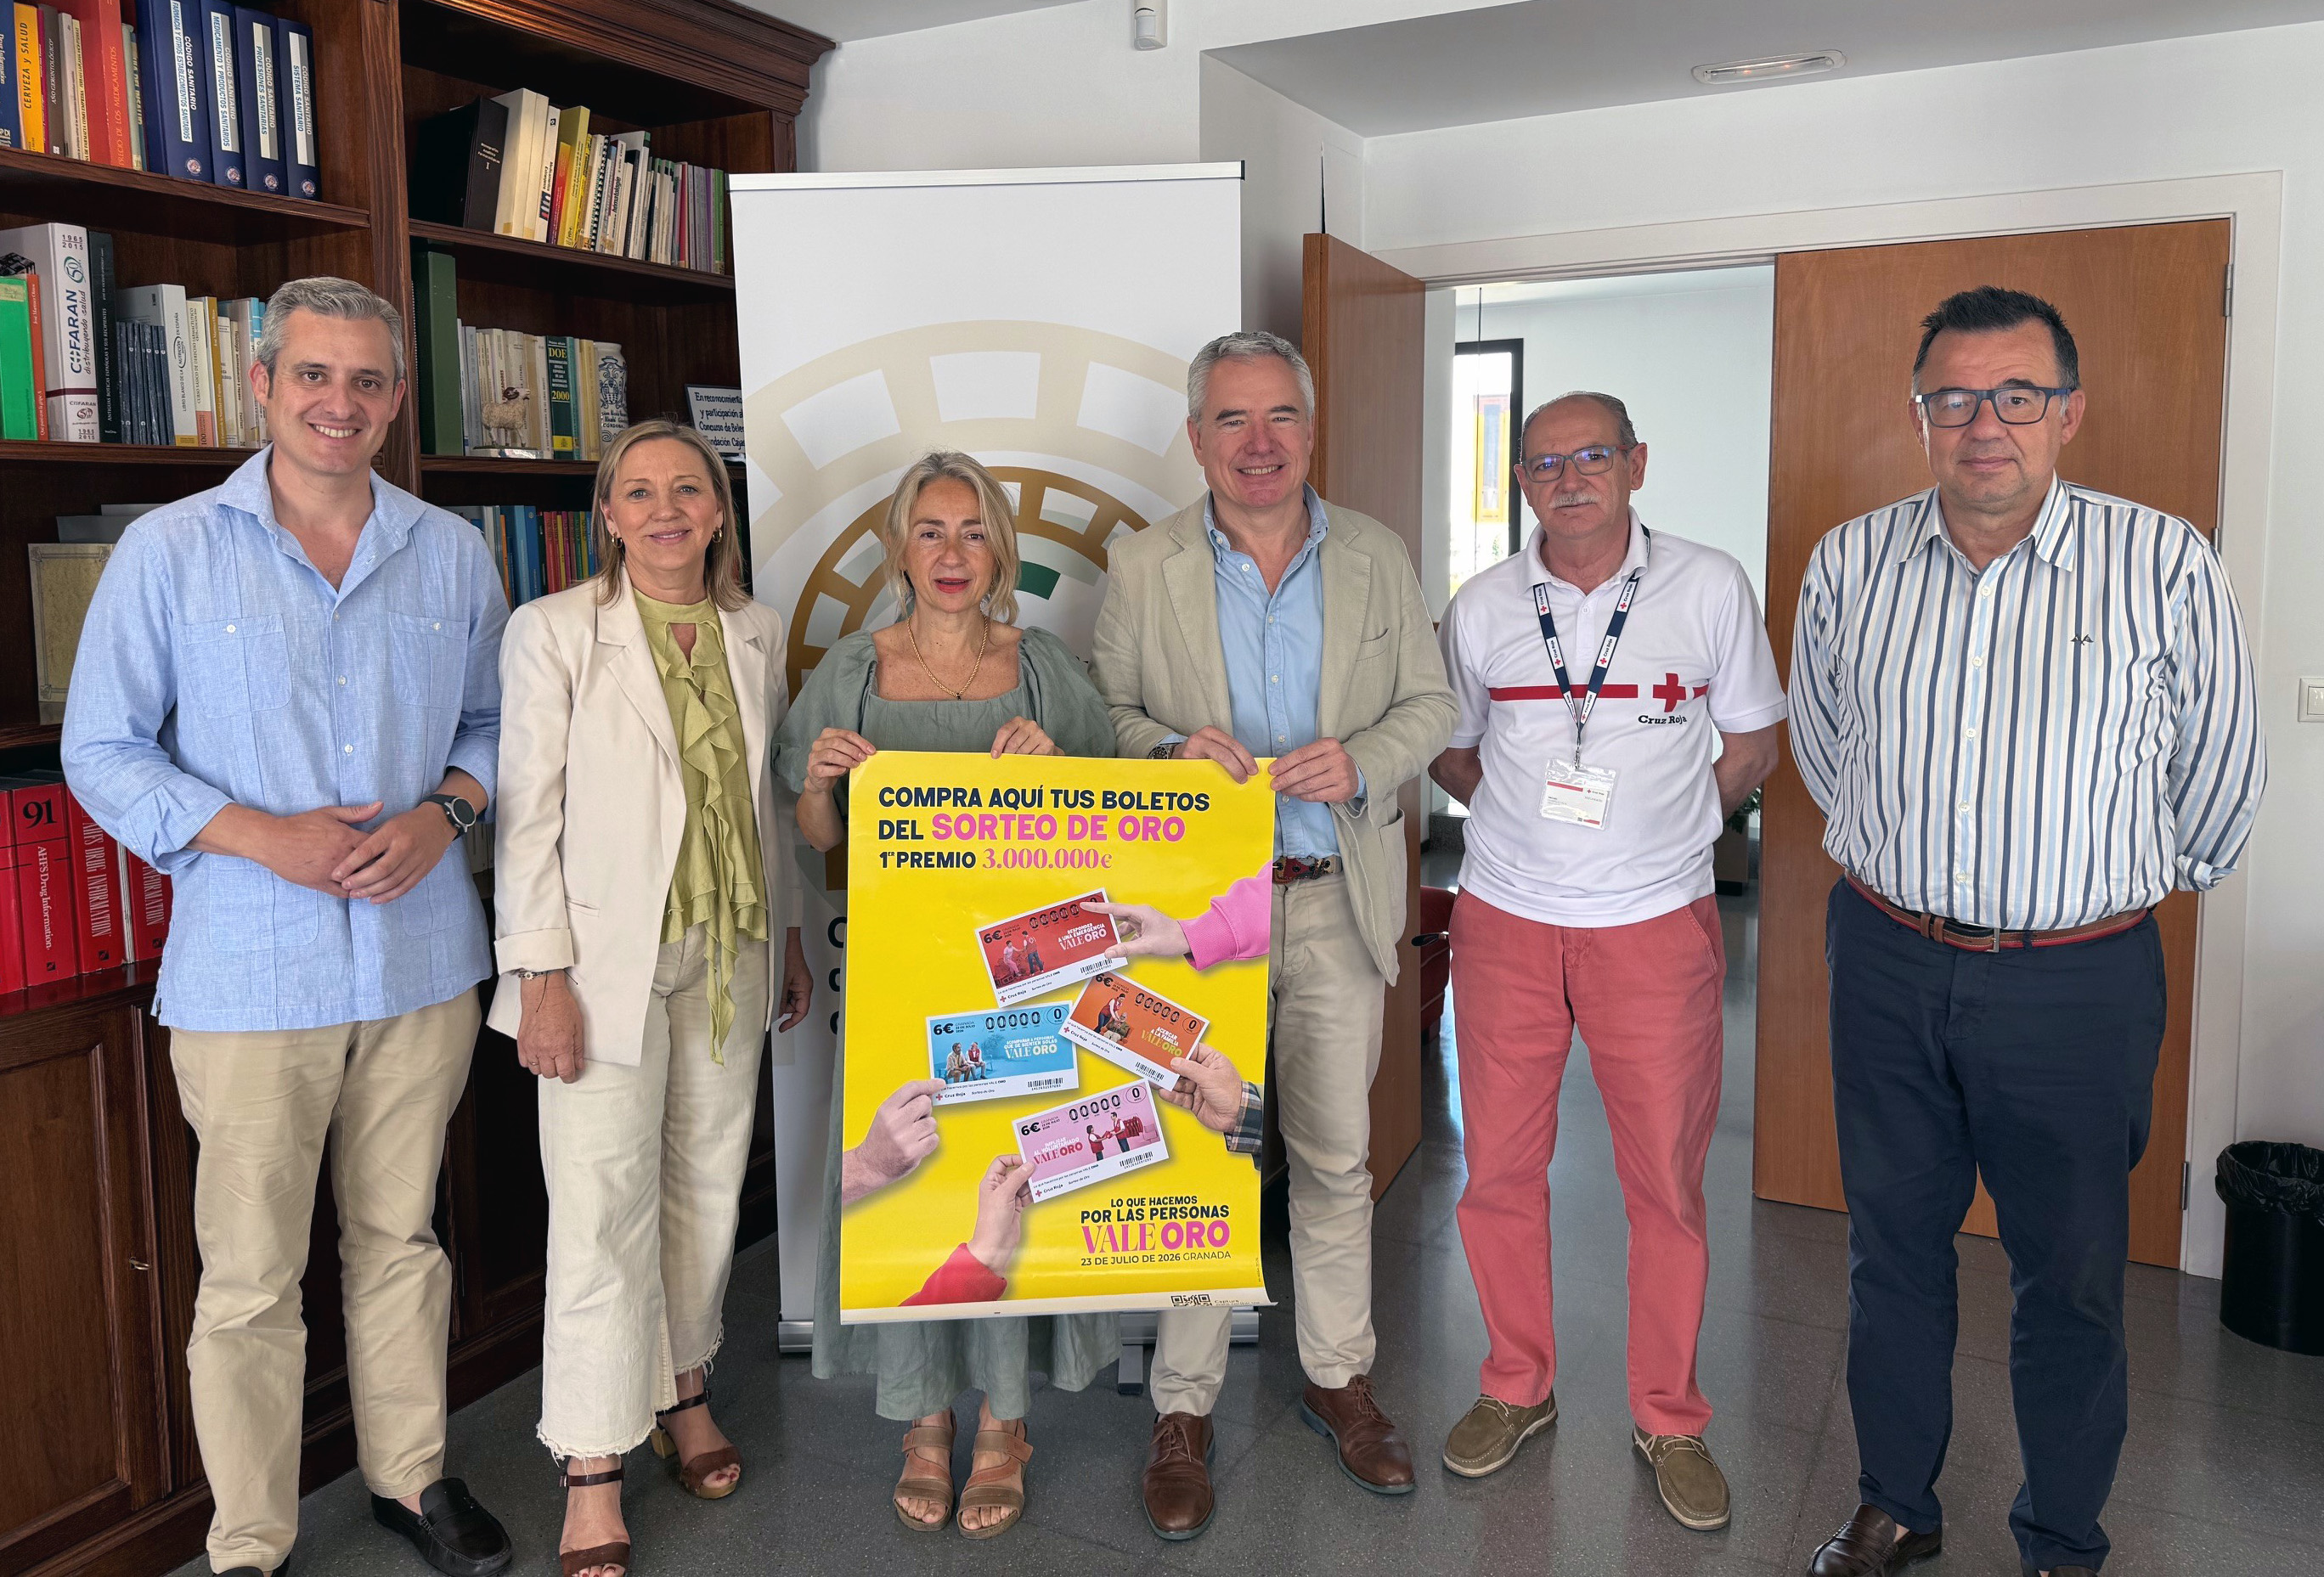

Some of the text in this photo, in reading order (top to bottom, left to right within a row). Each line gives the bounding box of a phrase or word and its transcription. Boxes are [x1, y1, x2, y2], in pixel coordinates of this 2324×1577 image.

[172, 3, 181, 31] FARMACIA
[20, 22, 29, 54] SALUD
[110, 47, 120, 106] MEDICAMENTOS
[184, 36, 196, 110] CÓDIGO SANITARIO
[213, 15, 223, 63] MEDICAMENTO
[221, 110, 230, 147] SANITARIOS
[293, 65, 302, 95] SISTEMA
[21, 68, 32, 109] CERVEZA
[227, 79, 236, 120] SANITARIO
[257, 46, 268, 135] PROFESIONES SANITARIAS
[268, 88, 276, 128] SANITARIO
[115, 140, 125, 166] PRECIO
[62, 234, 83, 243] 1965
[62, 241, 83, 251] 2015
[79, 290, 92, 375] distribuyendo salud
[548, 347, 567, 358] DOE
[551, 390, 570, 401] 2000
[695, 391, 704, 402] En
[699, 420, 731, 432] Concurso de
[1637, 714, 1688, 725] Cruz Roja
[878, 785, 1210, 811] COMPRA AQUÍ TUS BOLETOS
[22, 797, 58, 829] 91
[878, 814, 1187, 842] DEL SORTEO DE ORO
[896, 851, 977, 870] PREMIO
[982, 848, 1113, 870] 3.000.000€
[38, 846, 53, 949] AHFS Drug Information
[87, 874, 111, 938] INFORMATION
[983, 930, 1003, 944] 6€
[1059, 929, 1107, 951] VALE ORO
[1095, 973, 1114, 988] 6€
[933, 1022, 955, 1036] 6€
[1005, 1044, 1058, 1059] VALE ORO
[1141, 1029, 1162, 1049] VALE
[1161, 1039, 1183, 1058] ORO
[1021, 1122, 1041, 1136] 6€
[1033, 1141, 1084, 1165] VALE ORO
[1080, 1204, 1230, 1224] POR LAS PERSONAS
[1110, 1195, 1198, 1208] LO QUE HACEMOS
[1081, 1219, 1231, 1254] VALE ORO
[1080, 1251, 1232, 1266] 23 DE JULIO DE 2026 GRANADA
